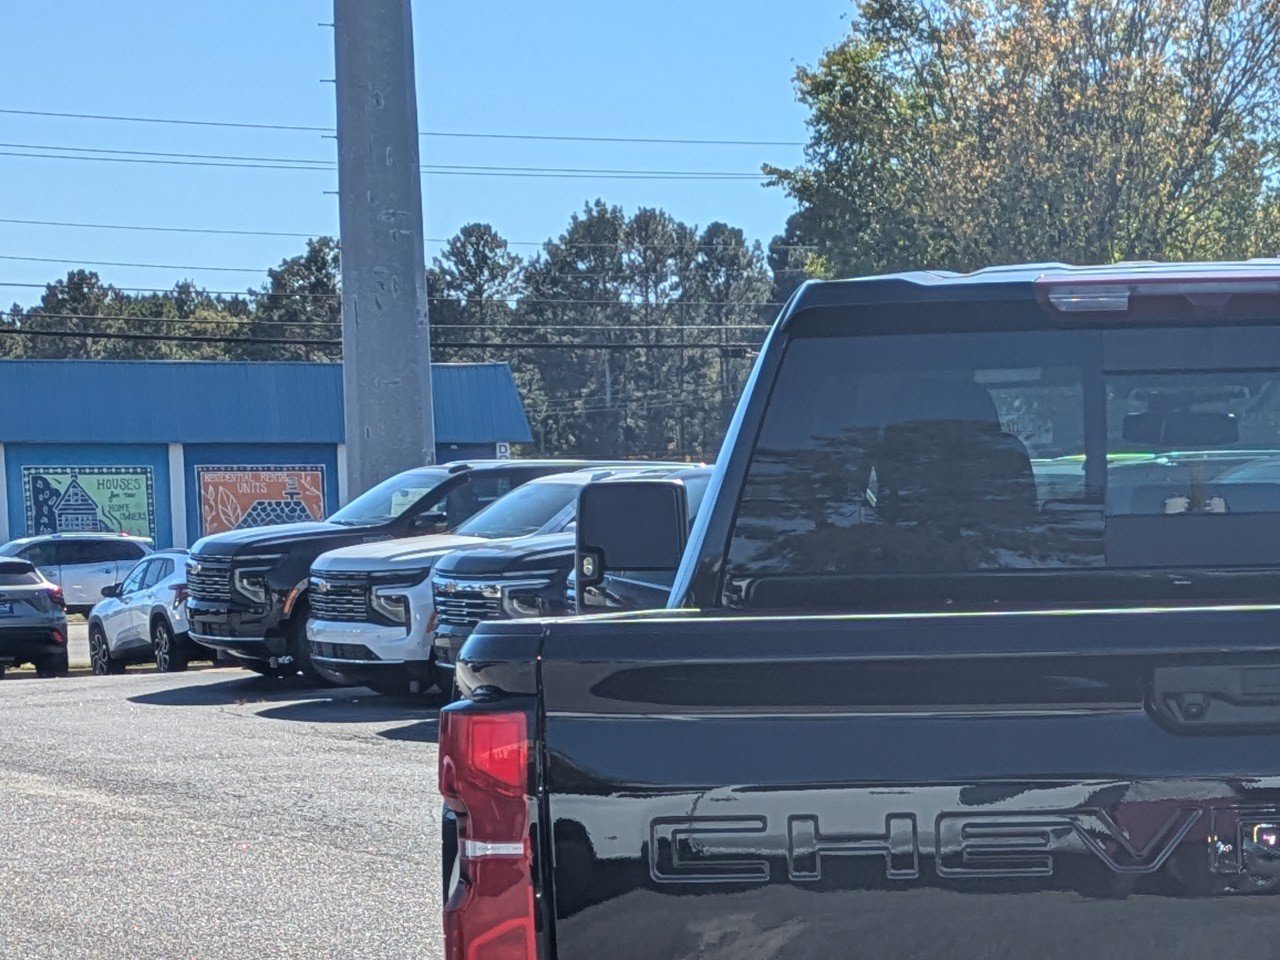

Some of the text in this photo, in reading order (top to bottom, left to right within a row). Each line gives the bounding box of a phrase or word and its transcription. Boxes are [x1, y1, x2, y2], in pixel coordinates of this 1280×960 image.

[204, 473, 253, 483] RESIDENTIAL
[96, 478, 141, 491] HOUSES
[237, 482, 268, 494] UNITS
[108, 504, 131, 512] HOME
